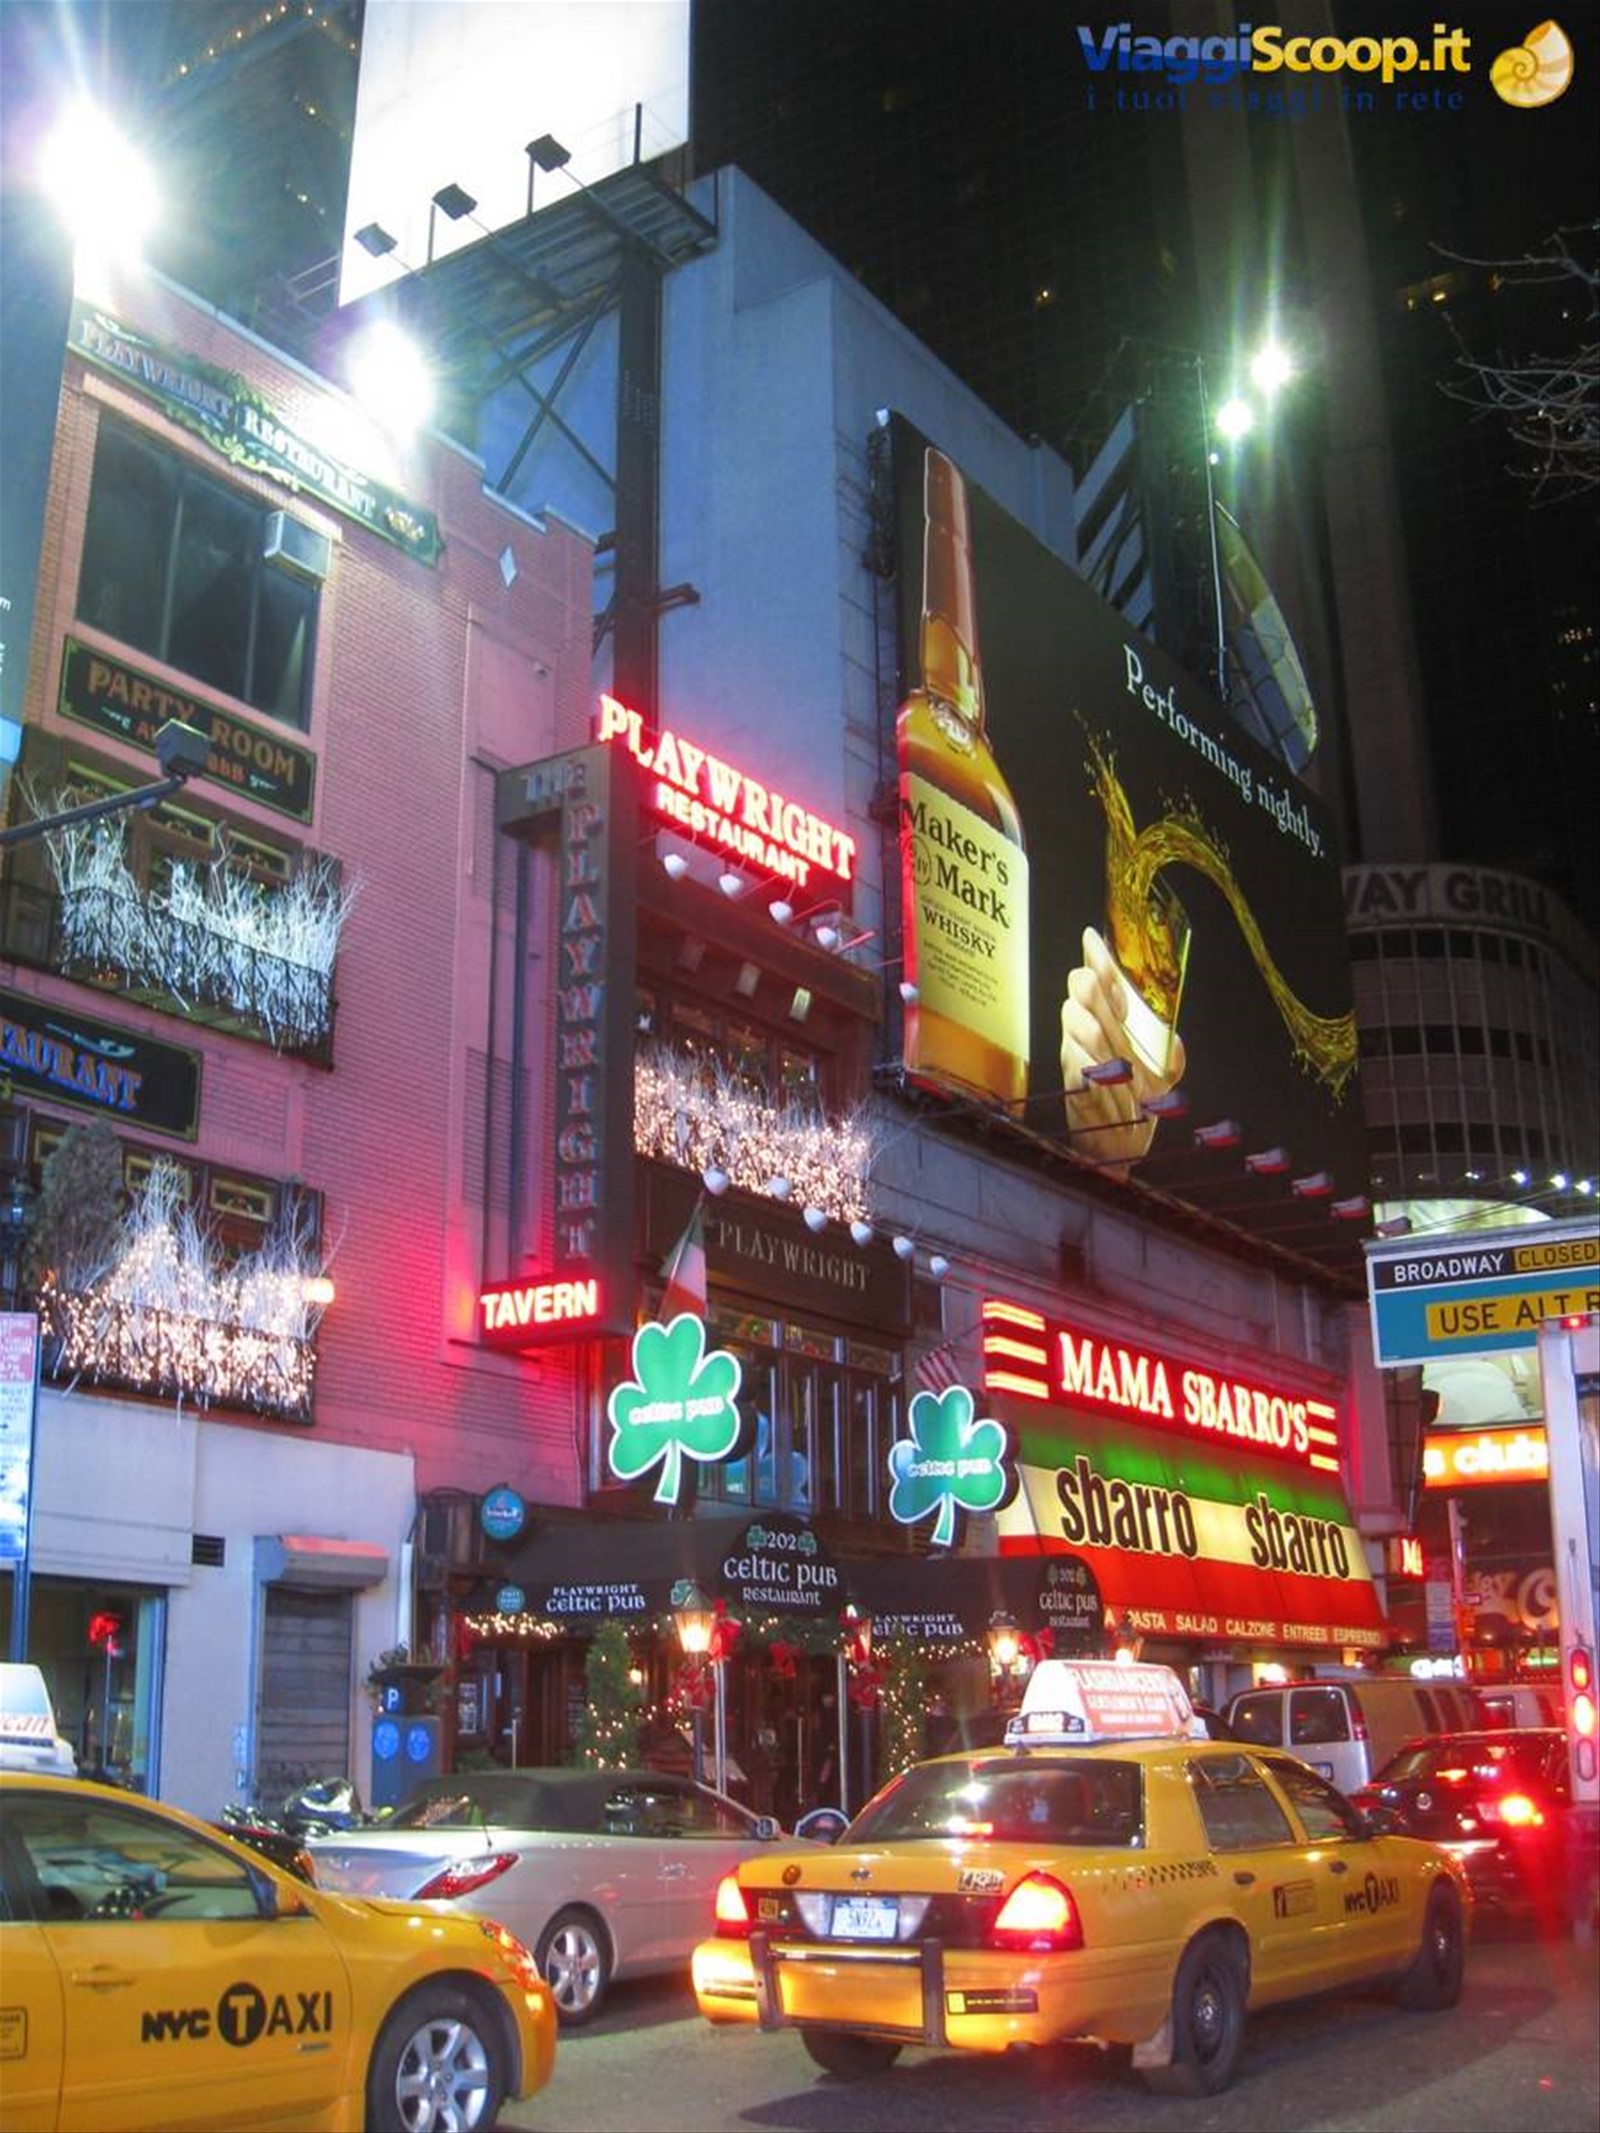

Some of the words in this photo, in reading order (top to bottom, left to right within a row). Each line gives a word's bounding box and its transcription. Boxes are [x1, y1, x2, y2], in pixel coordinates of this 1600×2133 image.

[244, 405, 377, 518] RESTAURANT
[88, 660, 195, 721] PARTY
[212, 717, 296, 787] ROOM
[1123, 644, 1252, 802] Performing
[1257, 776, 1324, 857] nightly.
[598, 693, 855, 880] PLAYWRIGHT
[657, 782, 810, 887] RESTAURANT
[899, 800, 1009, 887] Maker's
[936, 854, 1010, 929] Mark
[923, 905, 996, 958] WHISKY
[0, 1016, 142, 1110] AURANT
[558, 804, 602, 1258] PLAYWRIGHT
[718, 1218, 870, 1291] PLAYWRIGHT
[1394, 1253, 1504, 1283] BROADWAY
[1518, 1242, 1597, 1268] CLOSED
[481, 1280, 597, 1330] TAVERN
[1440, 1303, 1499, 1334] USE
[1515, 1293, 1571, 1326] ALT
[1059, 1331, 1174, 1420] MAMA
[1181, 1370, 1309, 1452] SBARRO'S
[766, 1530, 797, 1550] 202
[1056, 1455, 1198, 1561] sbarro
[1245, 1492, 1351, 1580] sbarro
[552, 1583, 638, 1596] PLAYWRIGHT
[875, 1612, 956, 1623] LAYWRIGHT
[1175, 1614, 1219, 1634] SALAD
[1226, 1619, 1277, 1638] CALZONE
[1283, 1623, 1328, 1644] ENTREES
[141, 2009, 210, 2042] NYC
[219, 1986, 332, 2044] TAXI
